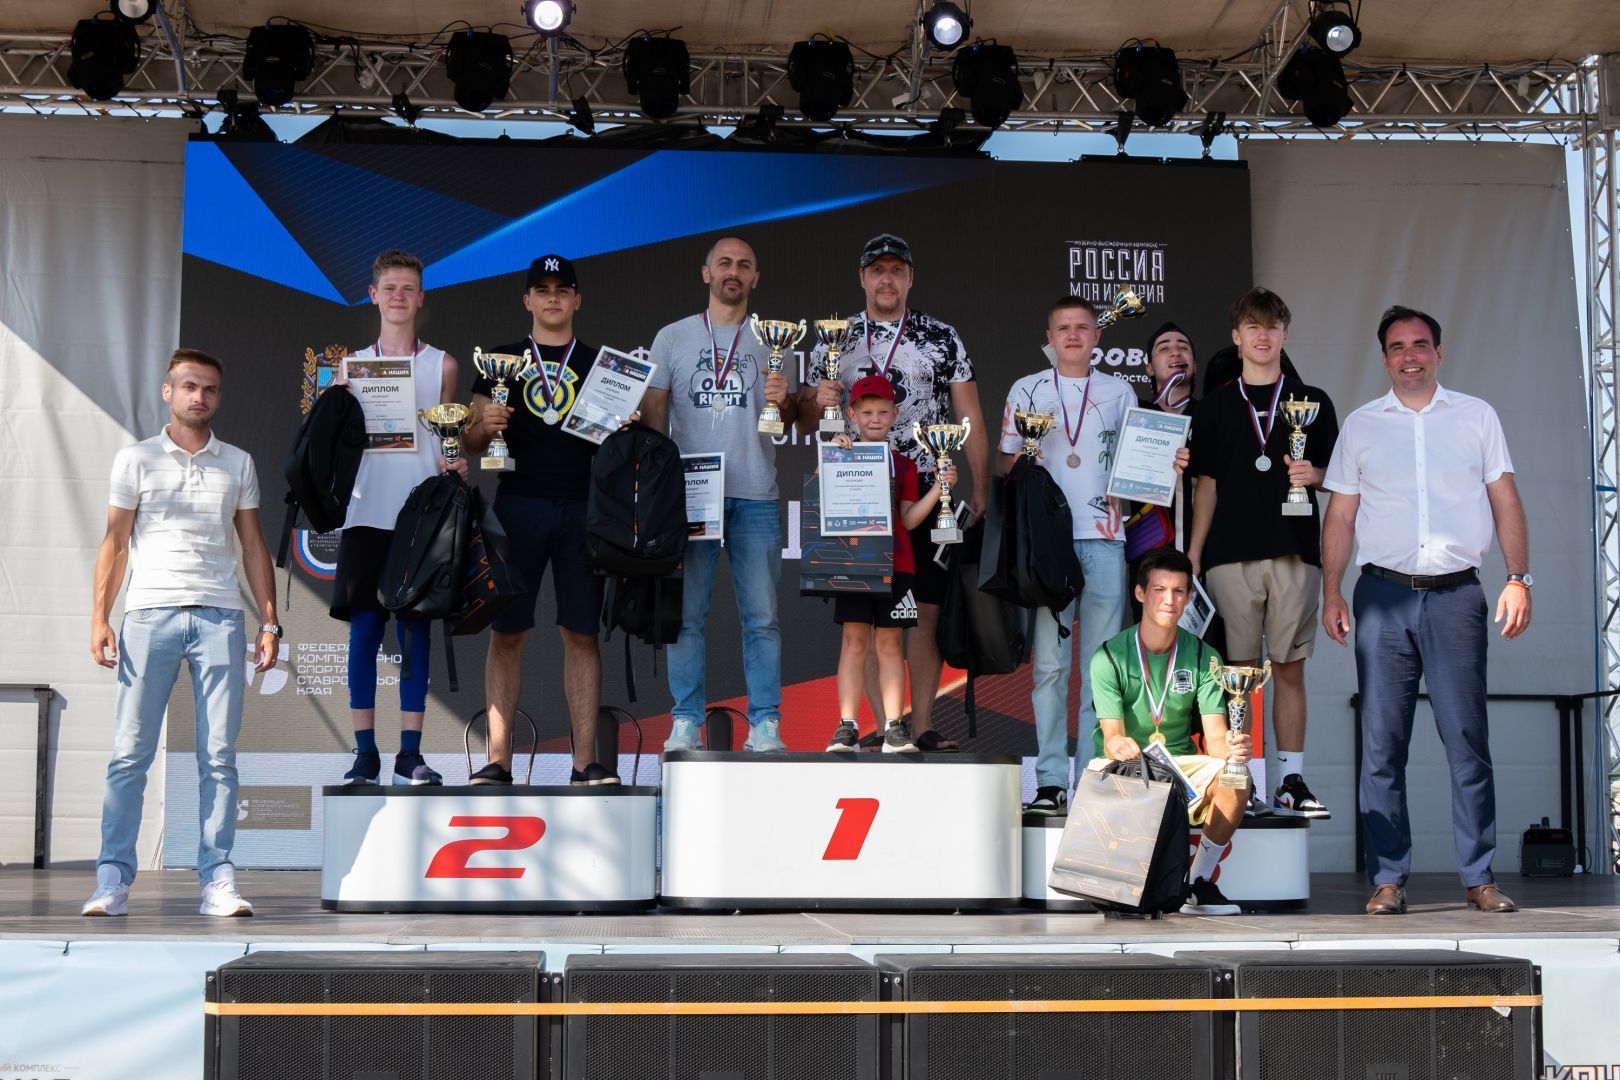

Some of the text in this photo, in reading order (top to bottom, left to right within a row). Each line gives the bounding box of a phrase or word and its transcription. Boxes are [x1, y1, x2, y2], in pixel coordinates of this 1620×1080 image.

[545, 258, 559, 271] NY
[1070, 247, 1165, 281] РОССИЯ
[362, 385, 399, 394] ДИПЛОМ
[600, 376, 631, 392] ДИПЛОМ
[1135, 435, 1170, 447] ДИПЛОМ
[836, 470, 873, 478] ДИПЛОМ
[297, 665, 349, 673] СПОРТА
[296, 687, 332, 696] КРАЯ
[822, 798, 880, 860] 1
[425, 816, 546, 878] 2
[14, 1064, 61, 1072] КОМПЛЕКС
